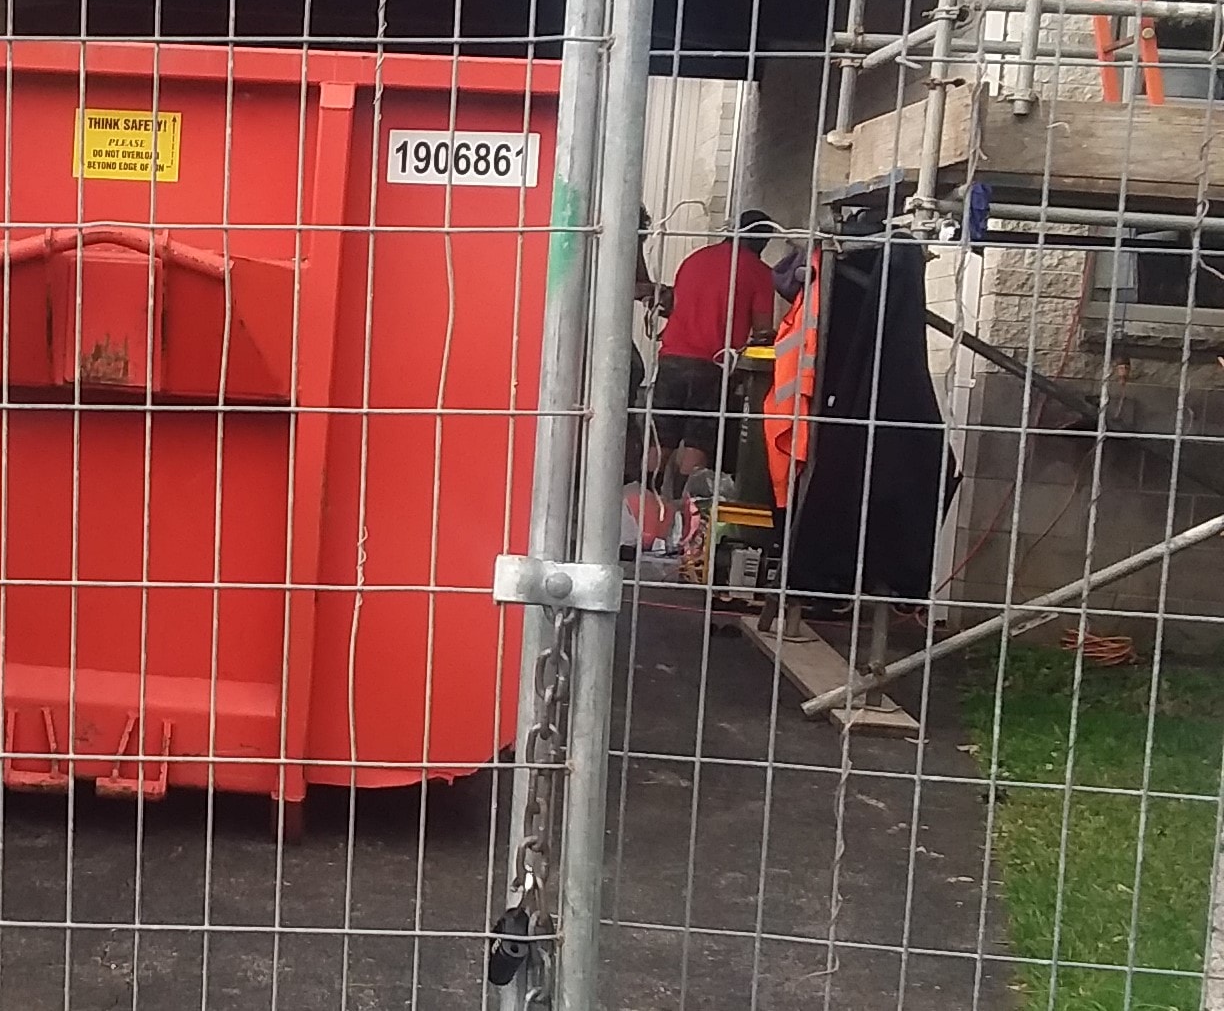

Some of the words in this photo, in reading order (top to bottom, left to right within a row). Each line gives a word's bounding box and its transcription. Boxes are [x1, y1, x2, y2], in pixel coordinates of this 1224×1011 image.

[88, 117, 120, 130] THINK
[108, 138, 146, 147] PLEASE
[93, 149, 103, 158] DO
[105, 150, 119, 158] NOT
[395, 140, 526, 176] 1906861
[119, 162, 137, 171] EDGE
[140, 163, 149, 171] OF
